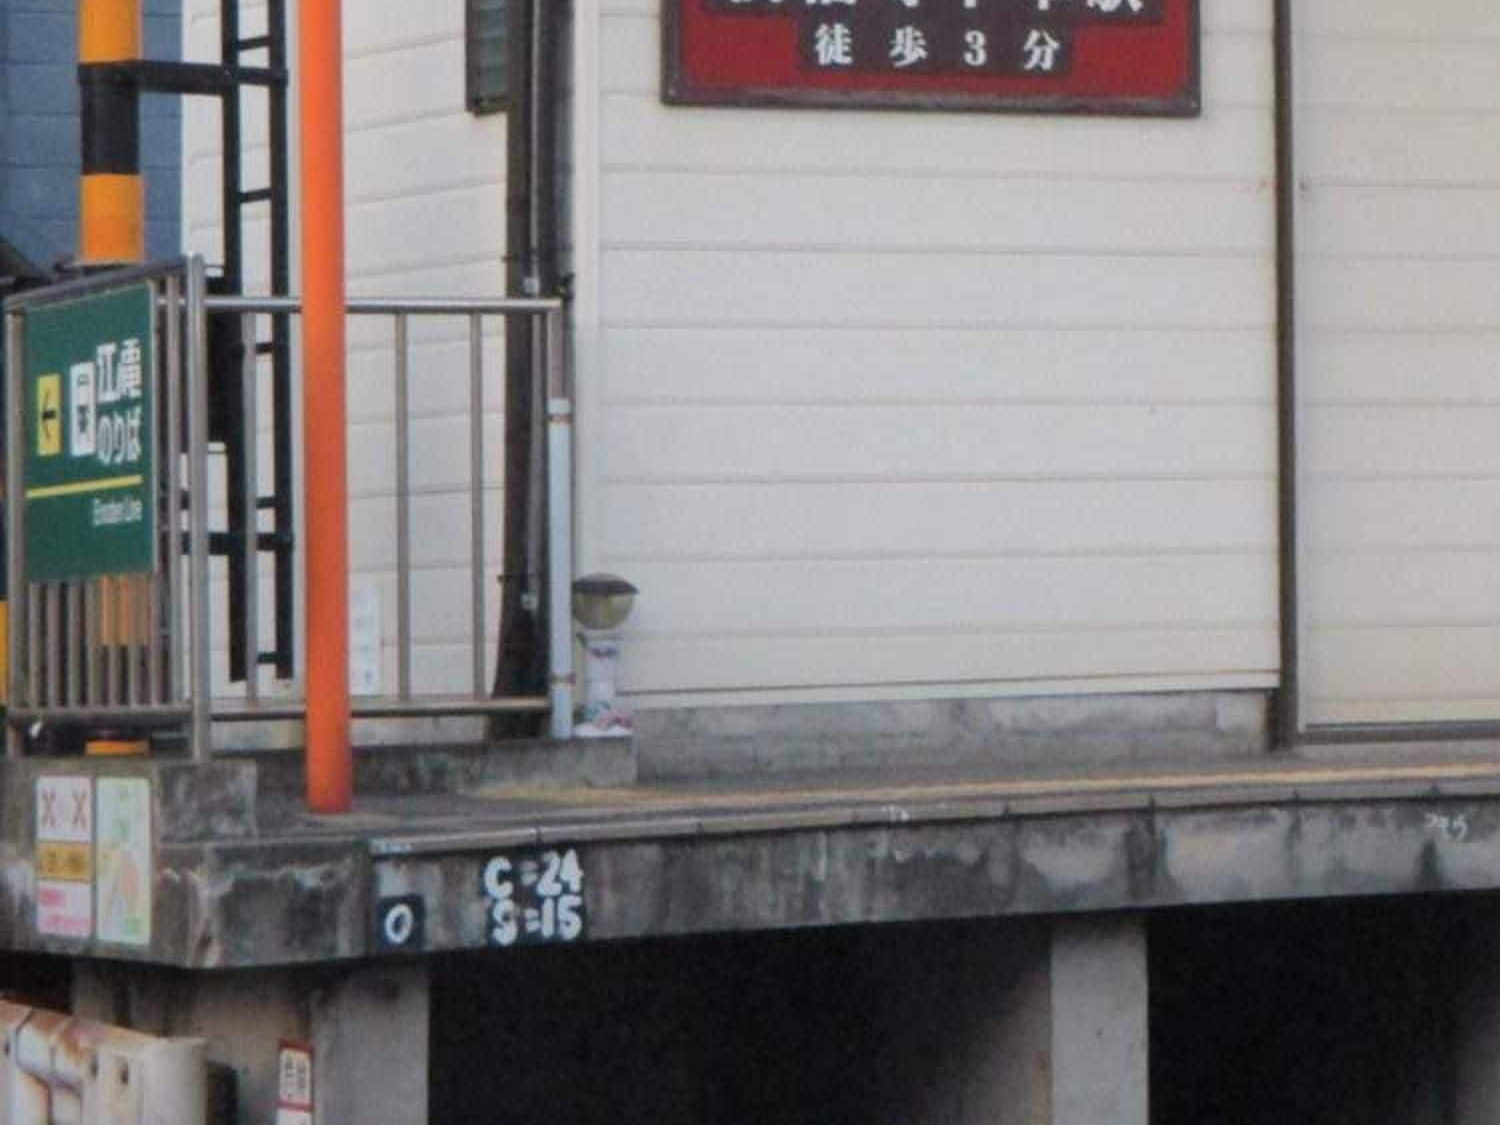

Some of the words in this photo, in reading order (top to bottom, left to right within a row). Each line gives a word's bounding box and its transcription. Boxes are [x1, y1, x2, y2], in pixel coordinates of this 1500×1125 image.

[814, 22, 1061, 72] 徒歩3分
[97, 404, 143, 465] のりば
